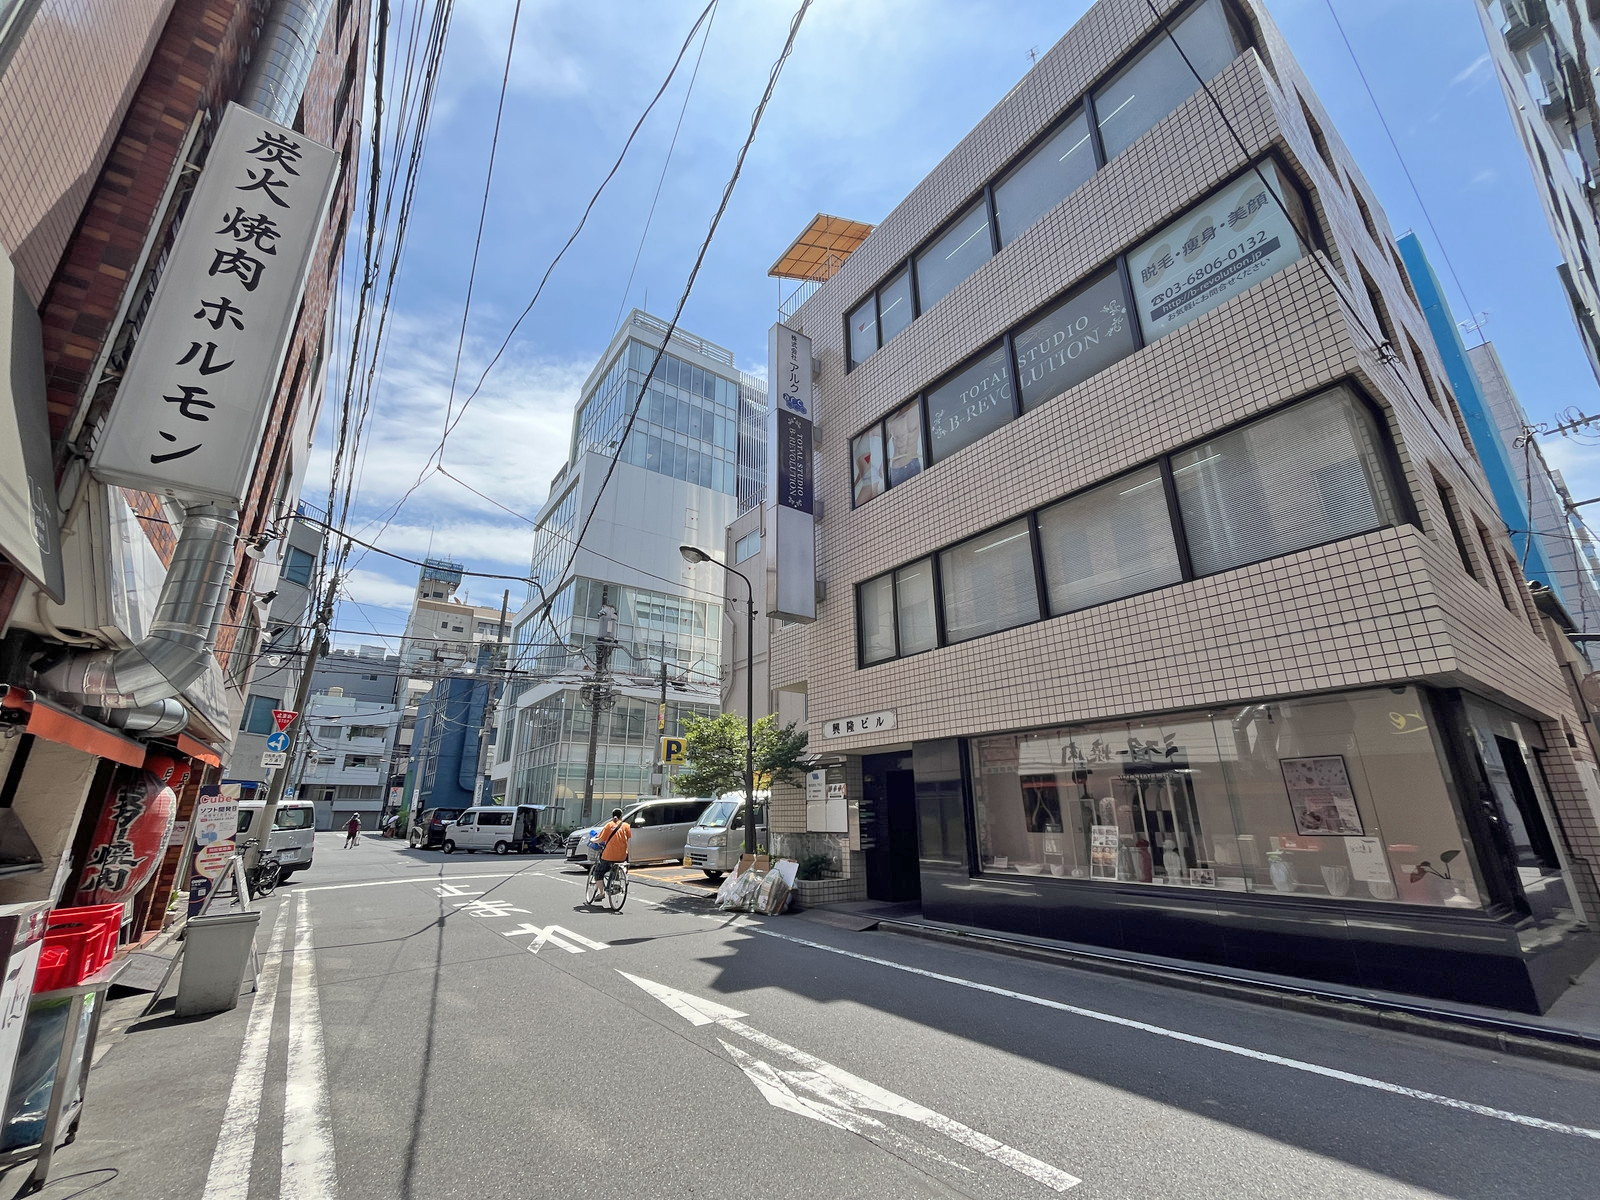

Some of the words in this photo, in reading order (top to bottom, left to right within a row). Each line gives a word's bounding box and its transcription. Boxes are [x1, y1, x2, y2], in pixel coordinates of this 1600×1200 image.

[1140, 190, 1269, 285] 脱毛・痩身・美顔
[1164, 229, 1269, 299] 03-6806-0132
[151, 131, 302, 465] 炭火焼肉ホルモン
[1161, 249, 1264, 315] http://b-revolution.jp
[1167, 257, 1272, 322] お気軽にお問合せください
[959, 369, 1009, 402] TOTAL
[1017, 315, 1089, 370] STUDIO
[788, 427, 796, 496] B-REVOLUTION
[666, 740, 681, 761] P
[832, 716, 885, 735] 興隆ビル
[201, 795, 232, 804] Cube
